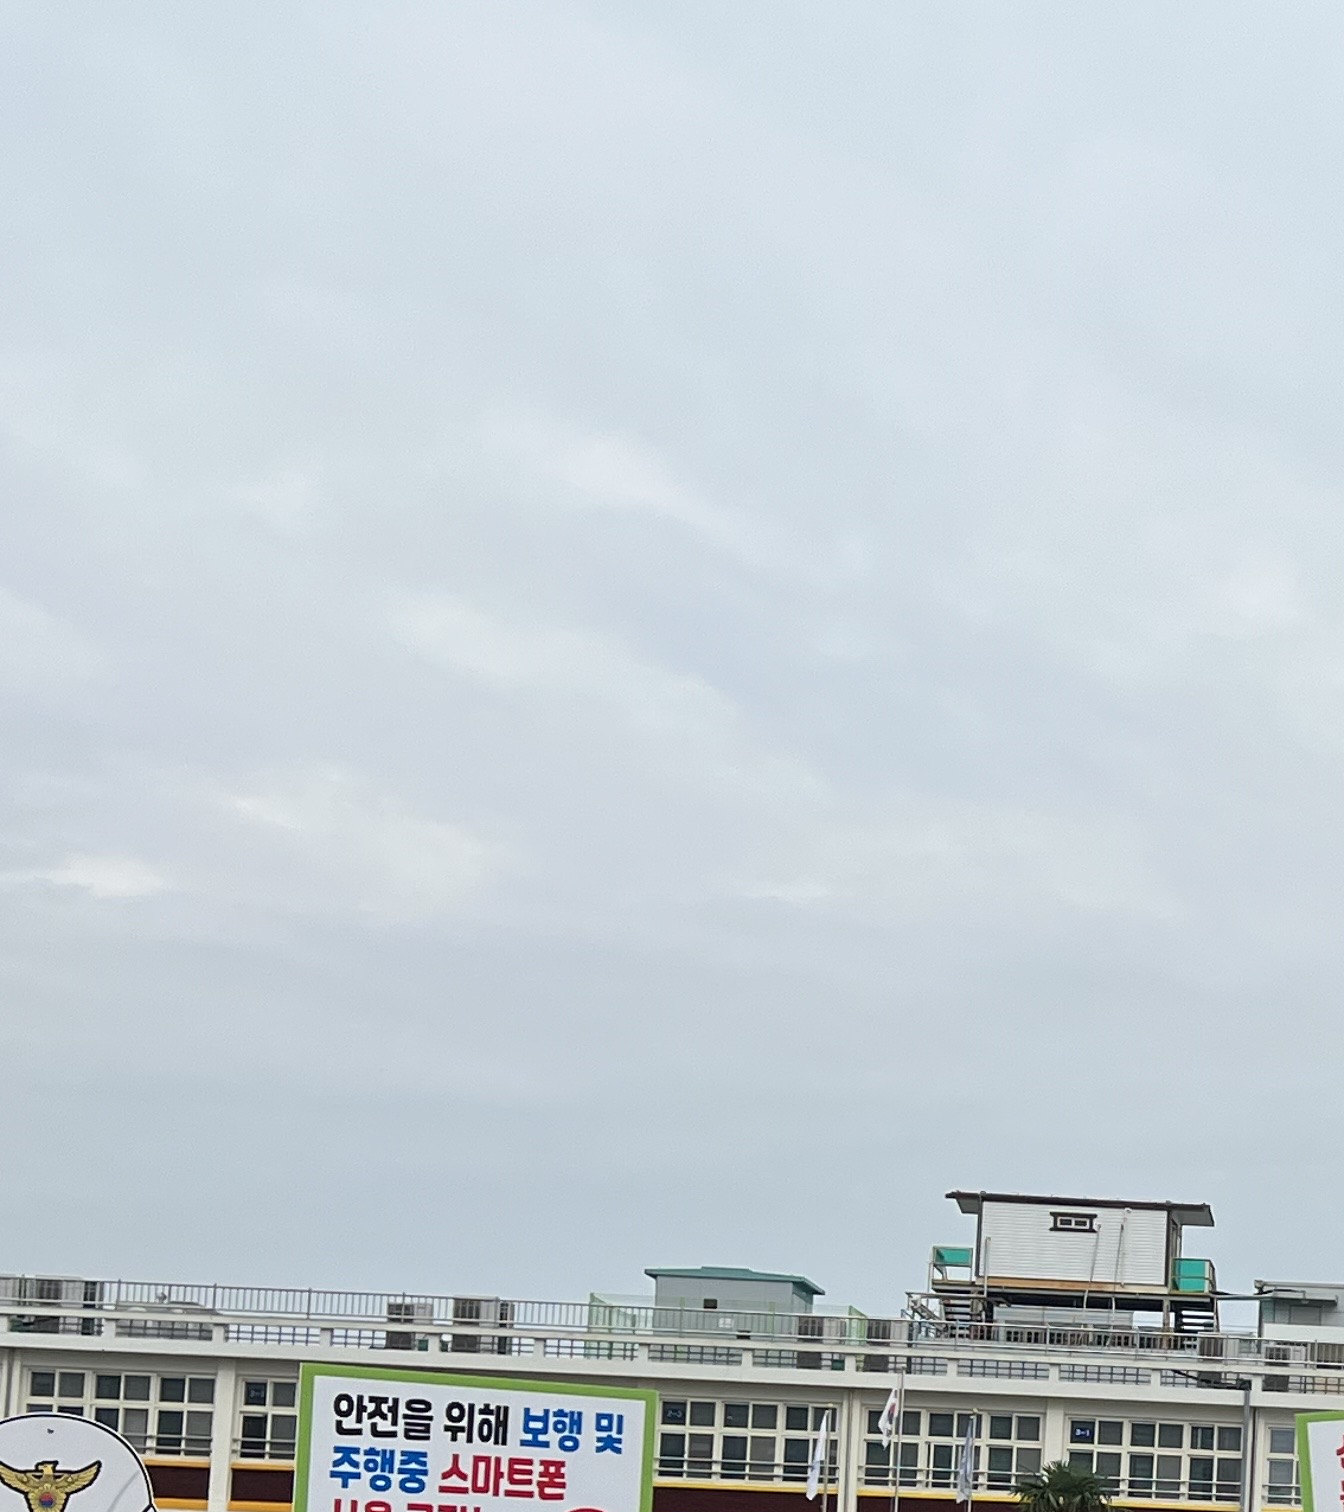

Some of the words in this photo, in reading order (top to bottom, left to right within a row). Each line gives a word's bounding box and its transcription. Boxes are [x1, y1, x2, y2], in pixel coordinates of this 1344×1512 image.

[332, 1392, 435, 1442] 안전을
[443, 1399, 510, 1449] 위해
[519, 1407, 583, 1453] 보행
[594, 1412, 625, 1455] 및
[329, 1445, 429, 1494] 주행중
[437, 1453, 568, 1501] 스마트폰
